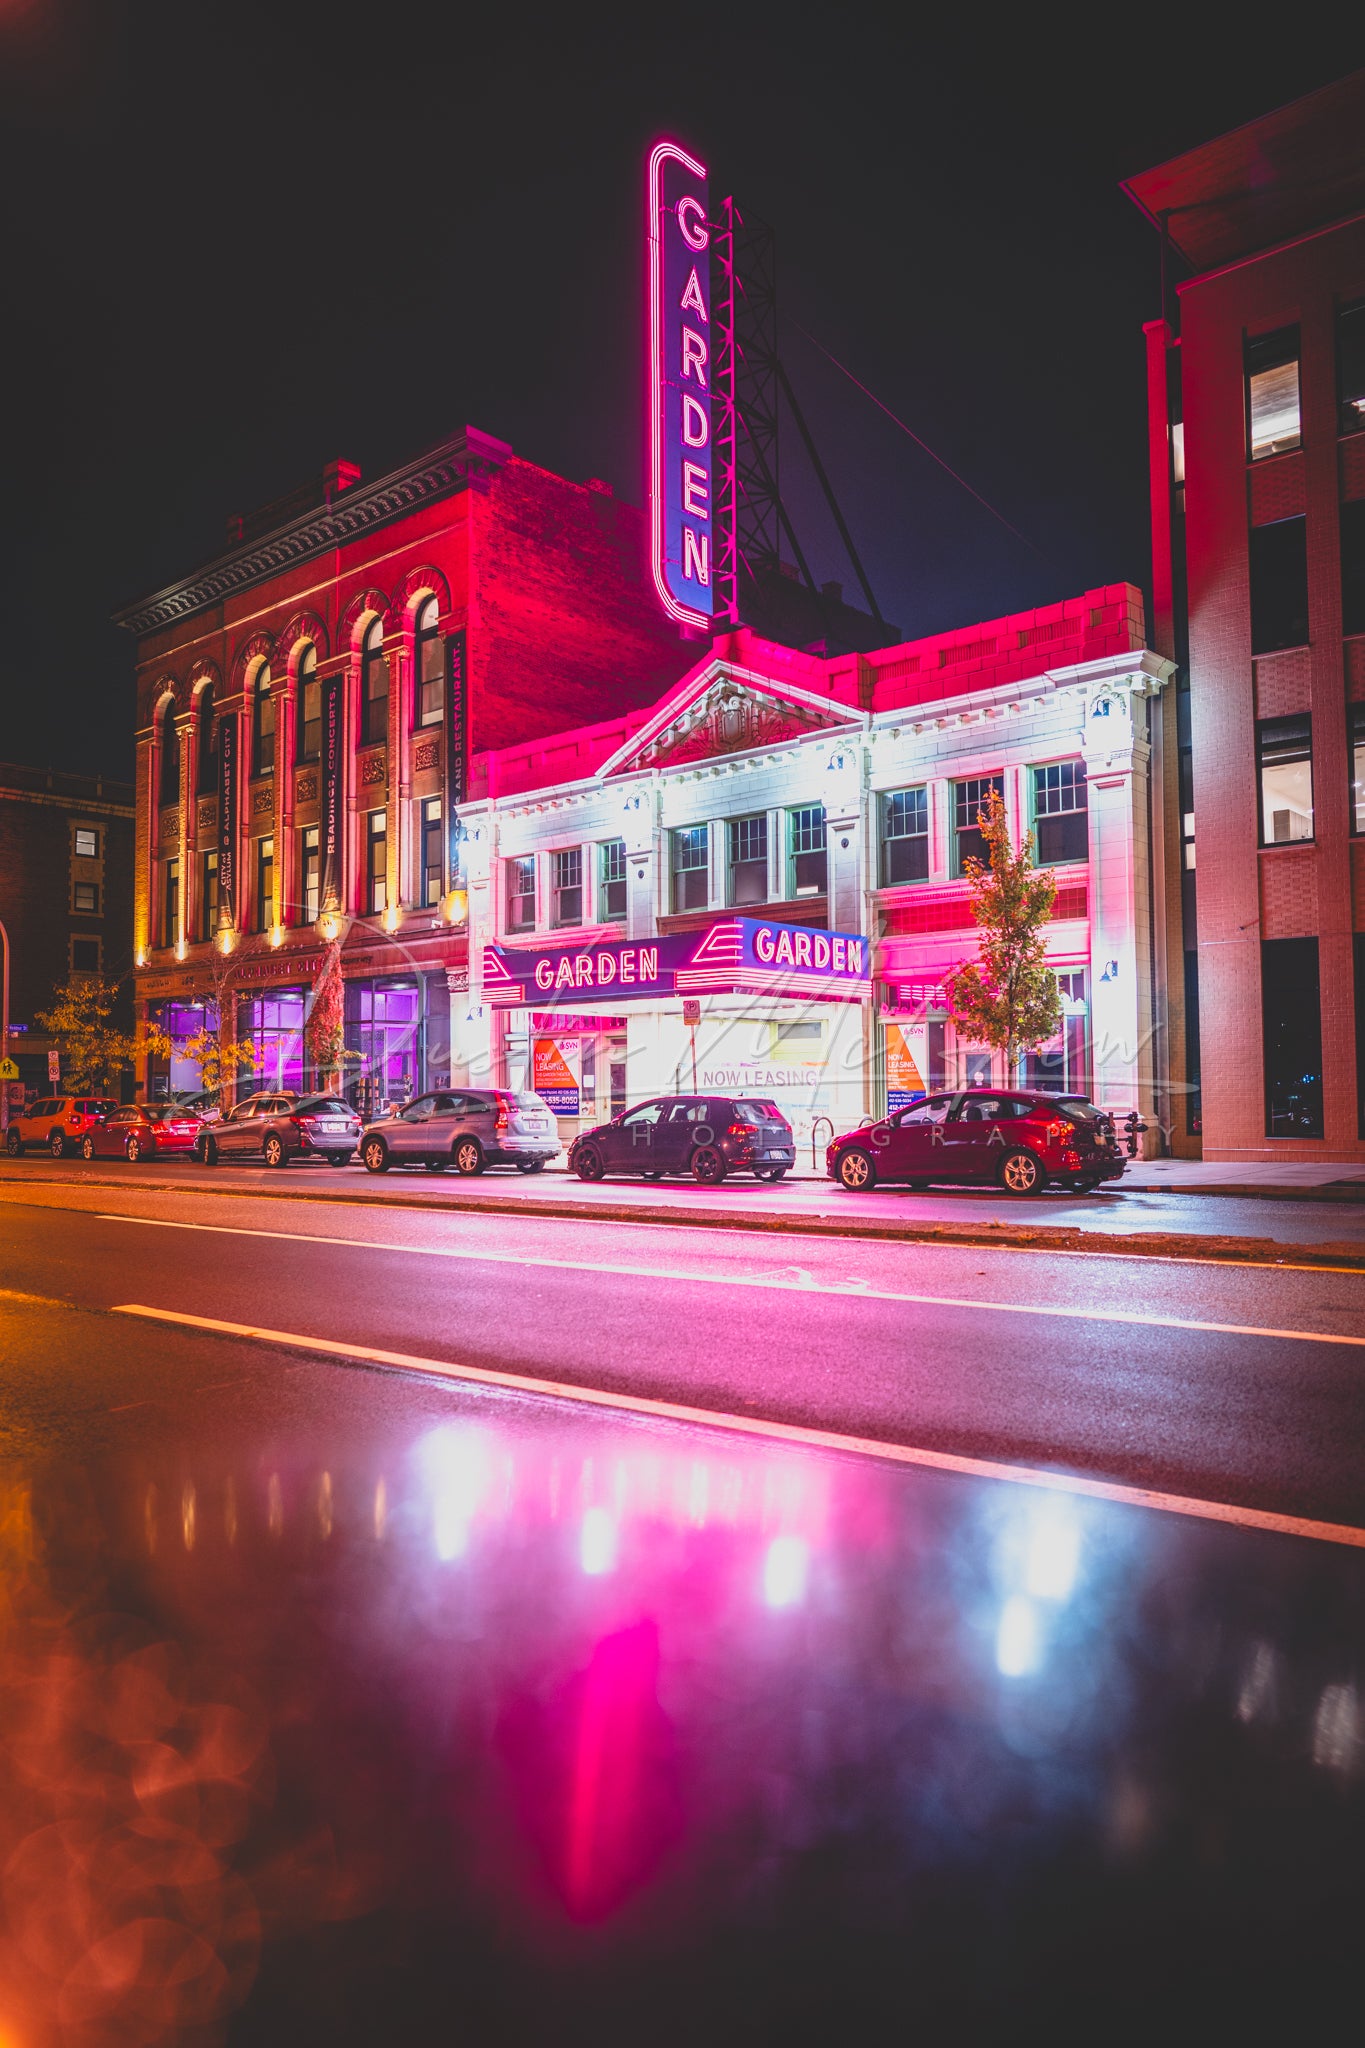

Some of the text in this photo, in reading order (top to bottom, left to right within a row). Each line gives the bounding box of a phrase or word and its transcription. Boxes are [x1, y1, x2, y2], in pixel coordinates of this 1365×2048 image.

[677, 195, 709, 586] GARDEN
[453, 641, 462, 751] RESTAURANT.
[223, 762, 231, 832] ALPHABET
[327, 774, 336, 854] READINGS,
[535, 947, 658, 991] GARDEN
[755, 926, 863, 974] GARDEN
[535, 1052, 552, 1061] NOW
[535, 1062, 564, 1072] LEASING
[565, 1042, 578, 1050] SVN
[887, 1061, 915, 1069] LEASING
[703, 1071, 817, 1087] NOW LEASING
